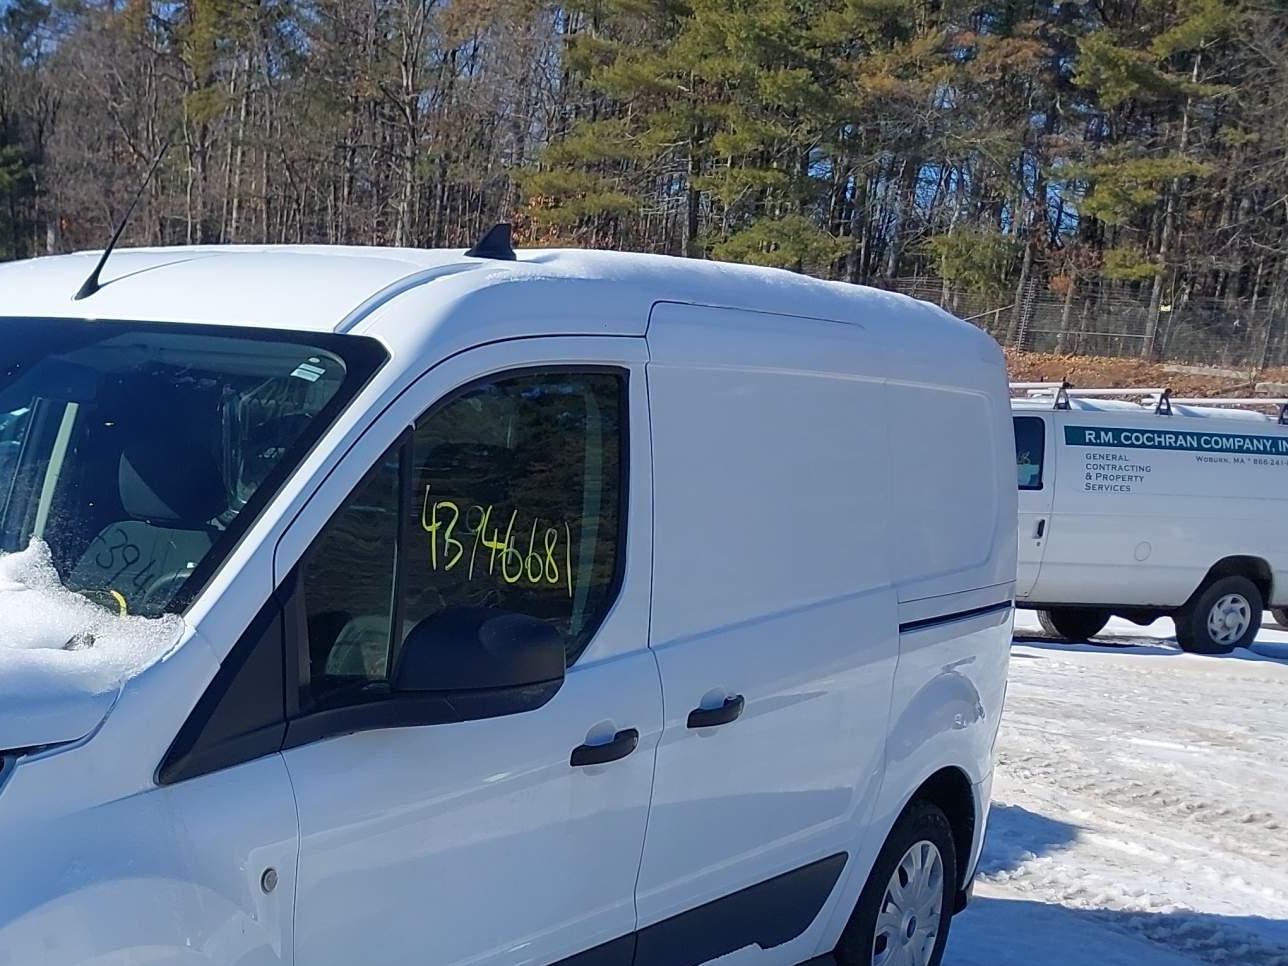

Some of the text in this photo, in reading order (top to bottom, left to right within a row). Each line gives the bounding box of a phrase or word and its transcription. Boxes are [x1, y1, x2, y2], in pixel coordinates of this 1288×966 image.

[1085, 430, 1118, 445] R.M.
[1120, 432, 1198, 448] COCHRAN
[1200, 436, 1276, 453] COMPANY,
[1085, 453, 1129, 462] GENERAL
[1085, 462, 1152, 473] CONTRACTING
[1085, 472, 1145, 483] & PROPERTY
[1084, 482, 1132, 492] SERVICES
[421, 484, 573, 598] 43946681
